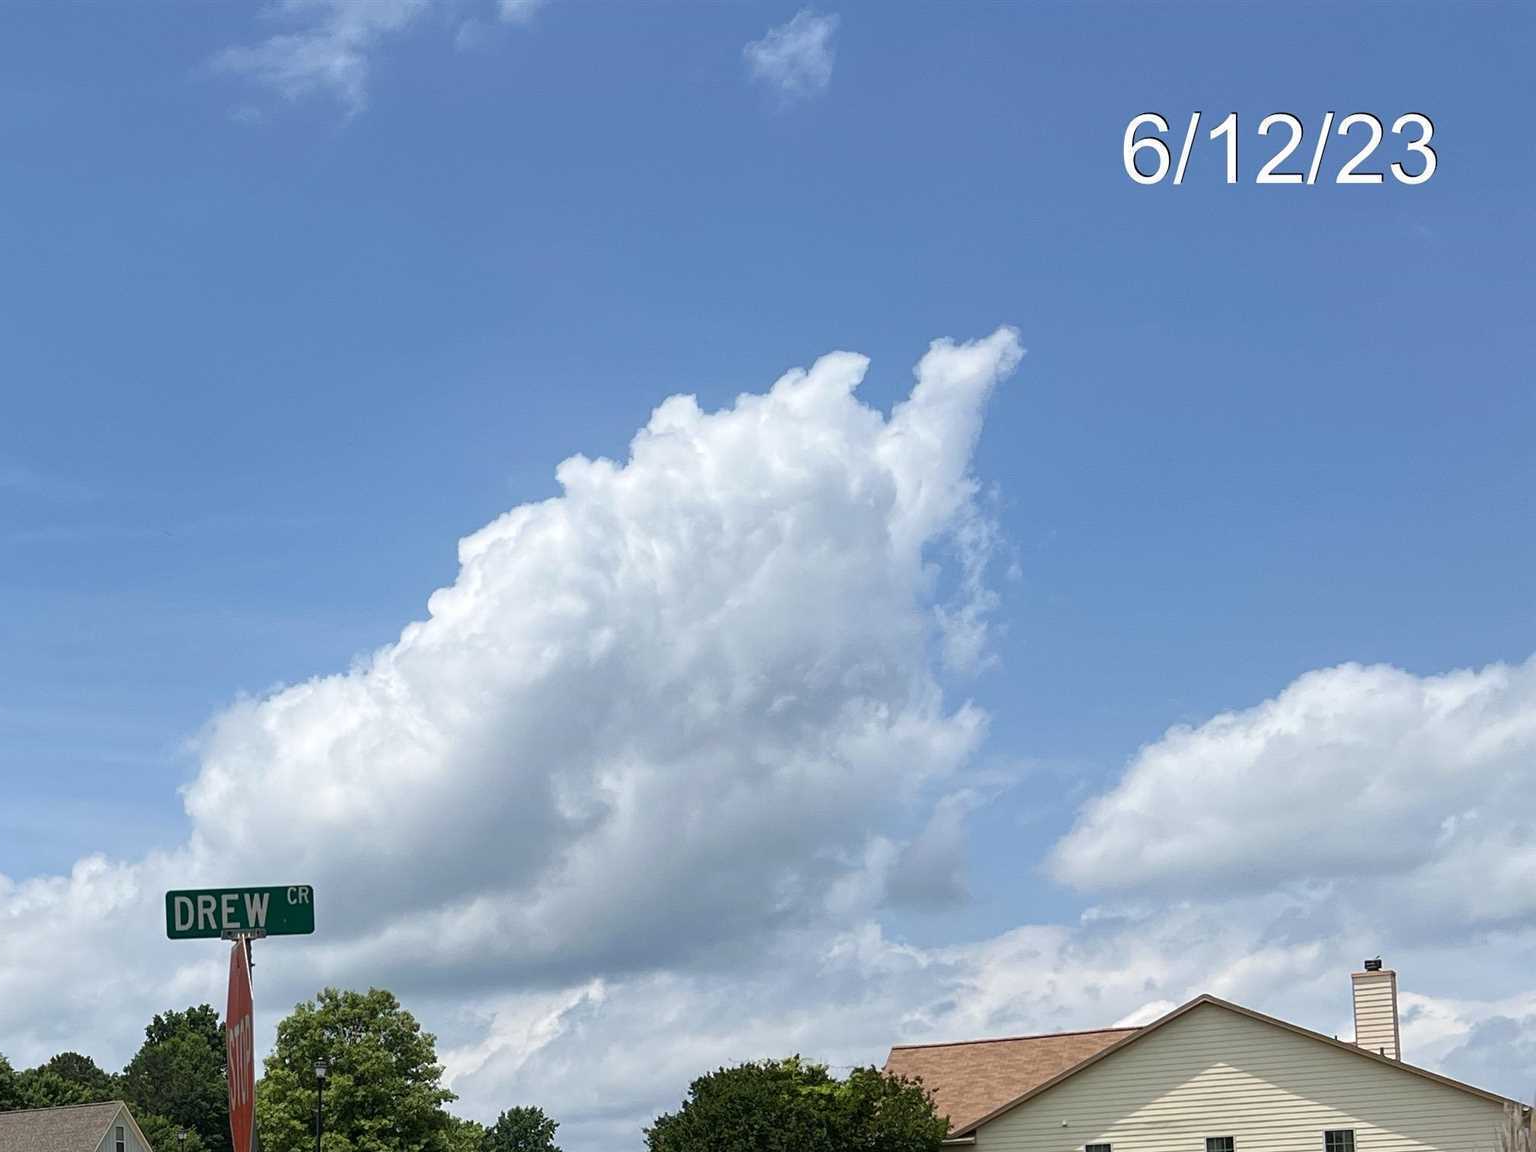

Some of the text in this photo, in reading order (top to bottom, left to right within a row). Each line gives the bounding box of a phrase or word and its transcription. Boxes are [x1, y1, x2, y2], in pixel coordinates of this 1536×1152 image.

[174, 886, 310, 931] DREW CR
[229, 1014, 252, 1111] STOP
